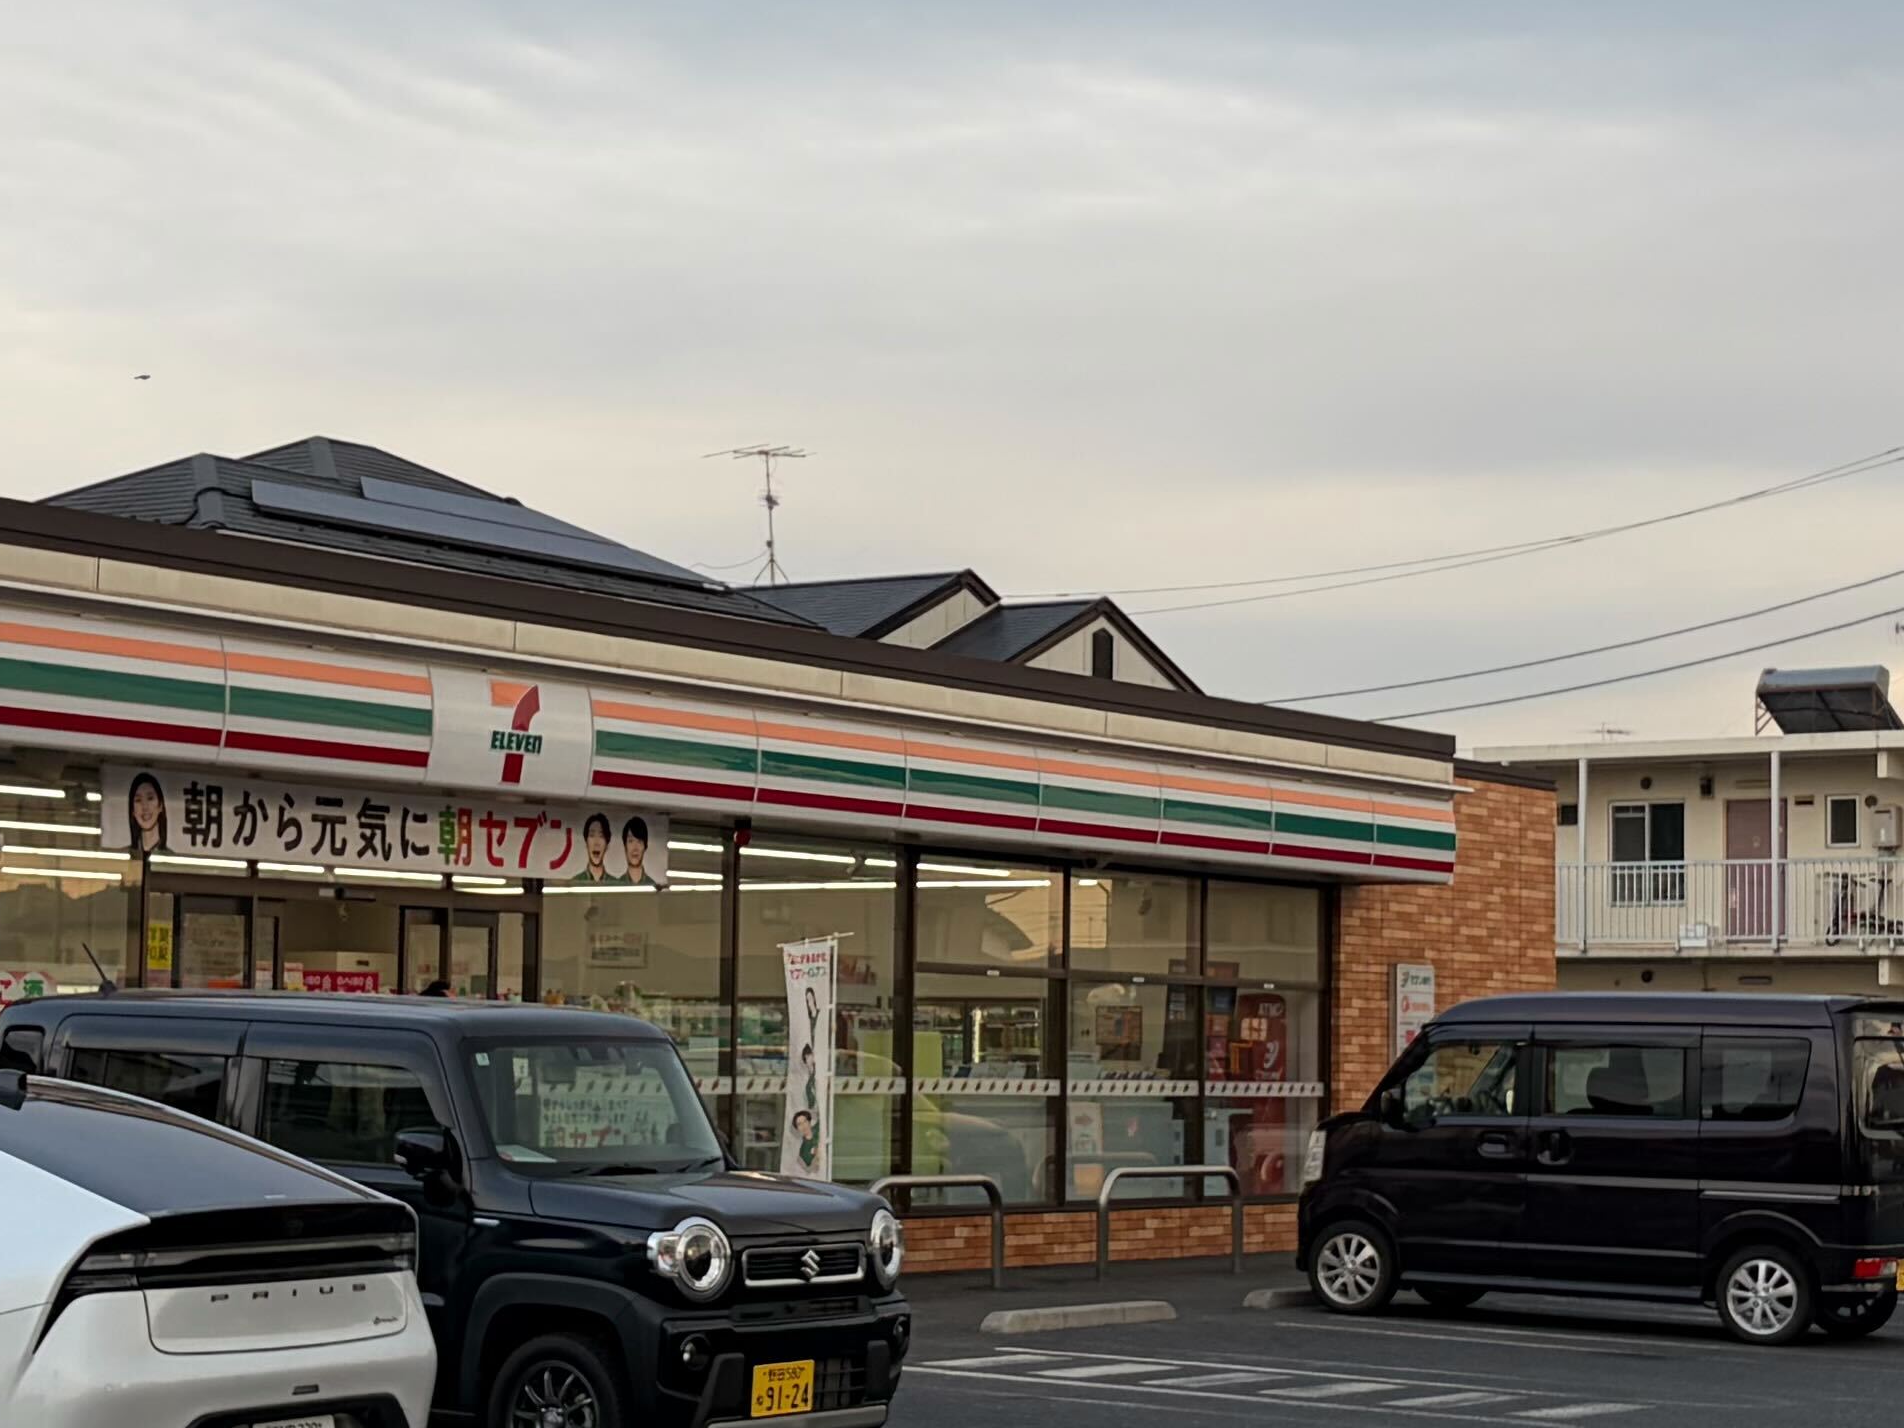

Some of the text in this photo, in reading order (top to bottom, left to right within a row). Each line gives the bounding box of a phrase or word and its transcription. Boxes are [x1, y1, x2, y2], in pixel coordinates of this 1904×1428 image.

[182, 780, 574, 870] 朝から元気に朝セブン
